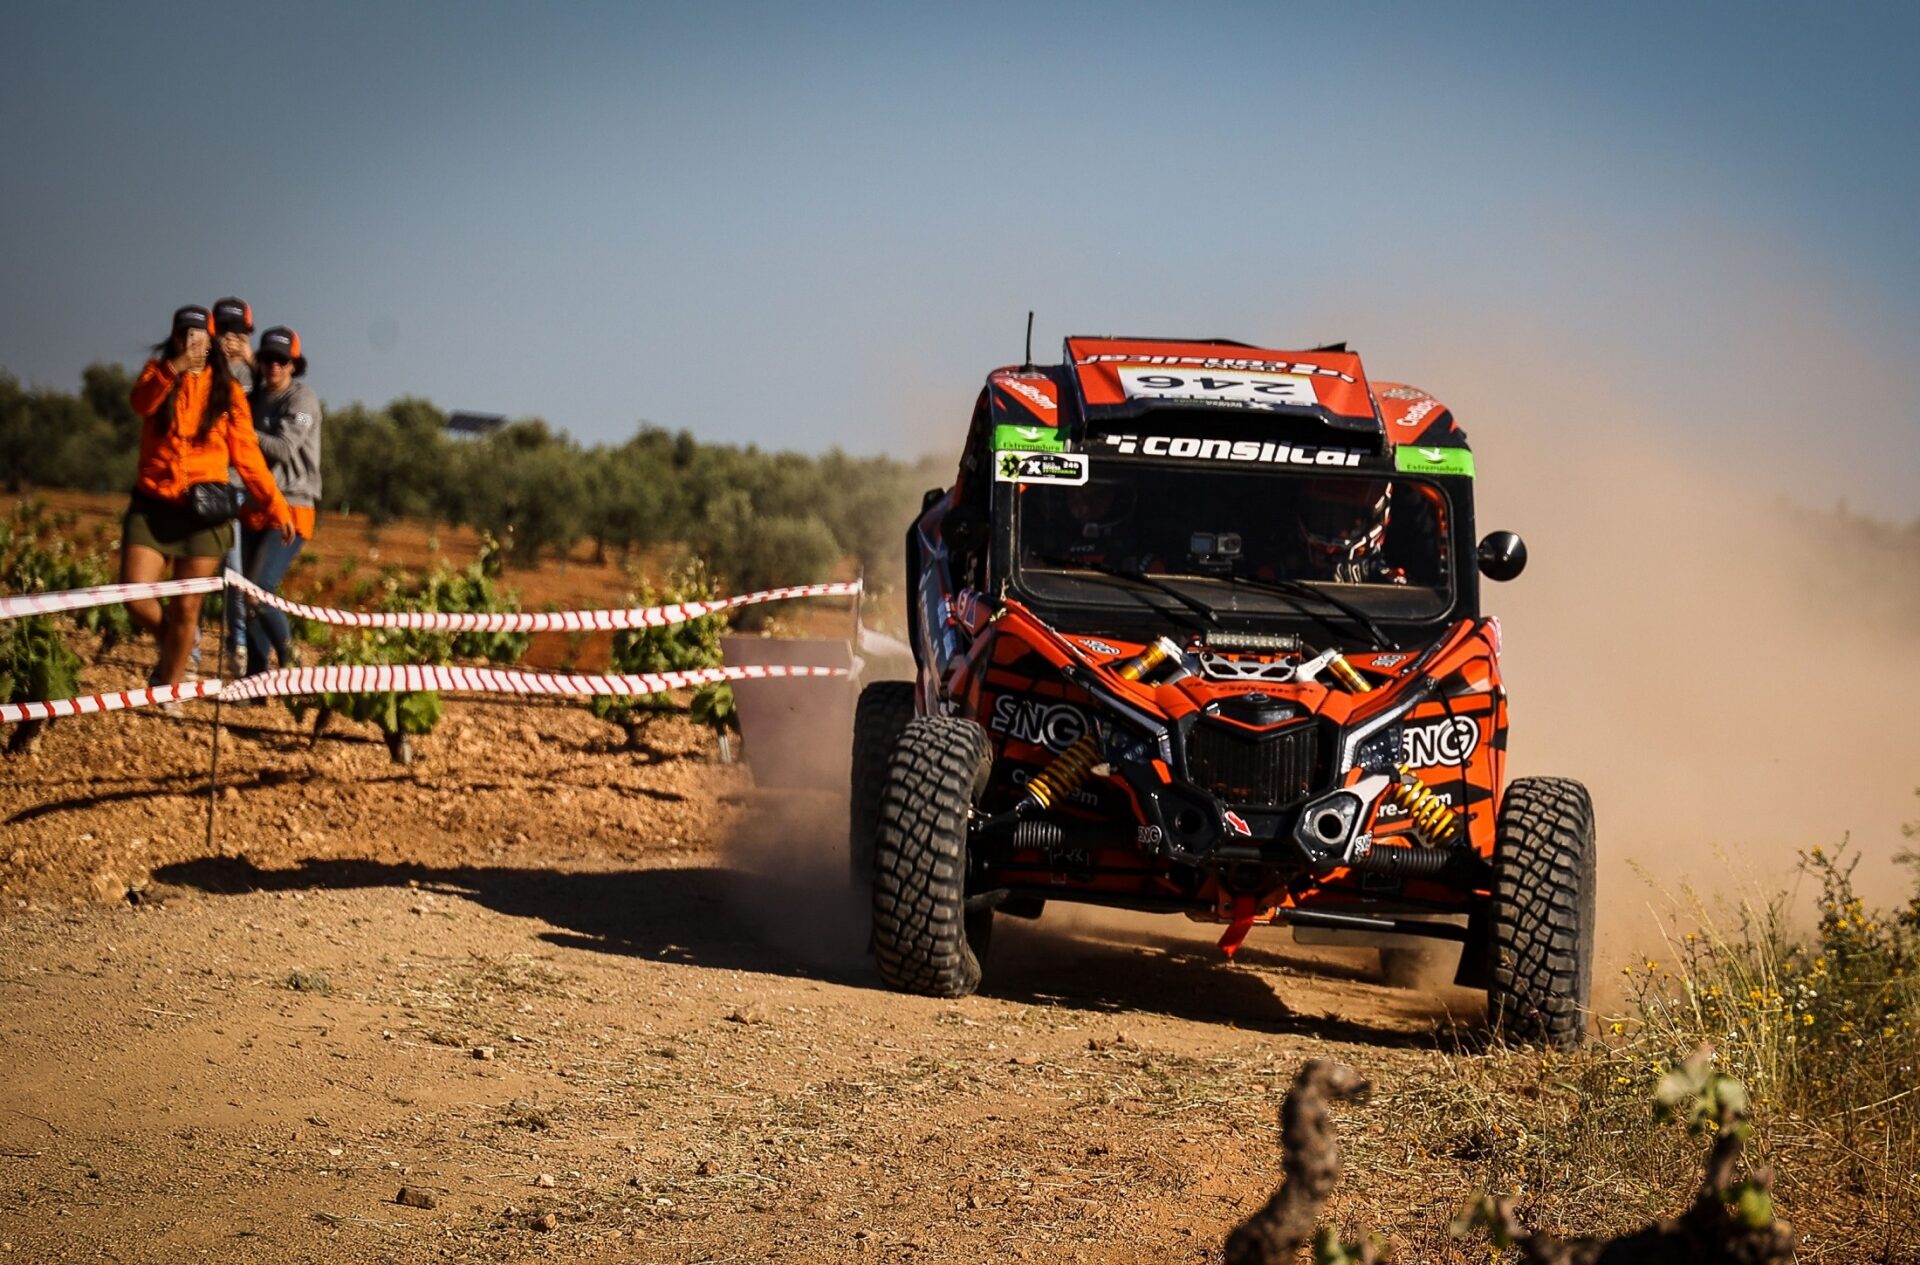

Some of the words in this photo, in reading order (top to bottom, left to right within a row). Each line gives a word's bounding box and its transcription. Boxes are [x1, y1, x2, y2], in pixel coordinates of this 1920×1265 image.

[1137, 376, 1295, 395] 246
[1406, 463, 1464, 473] Extremadura
[991, 694, 1090, 756] SNG
